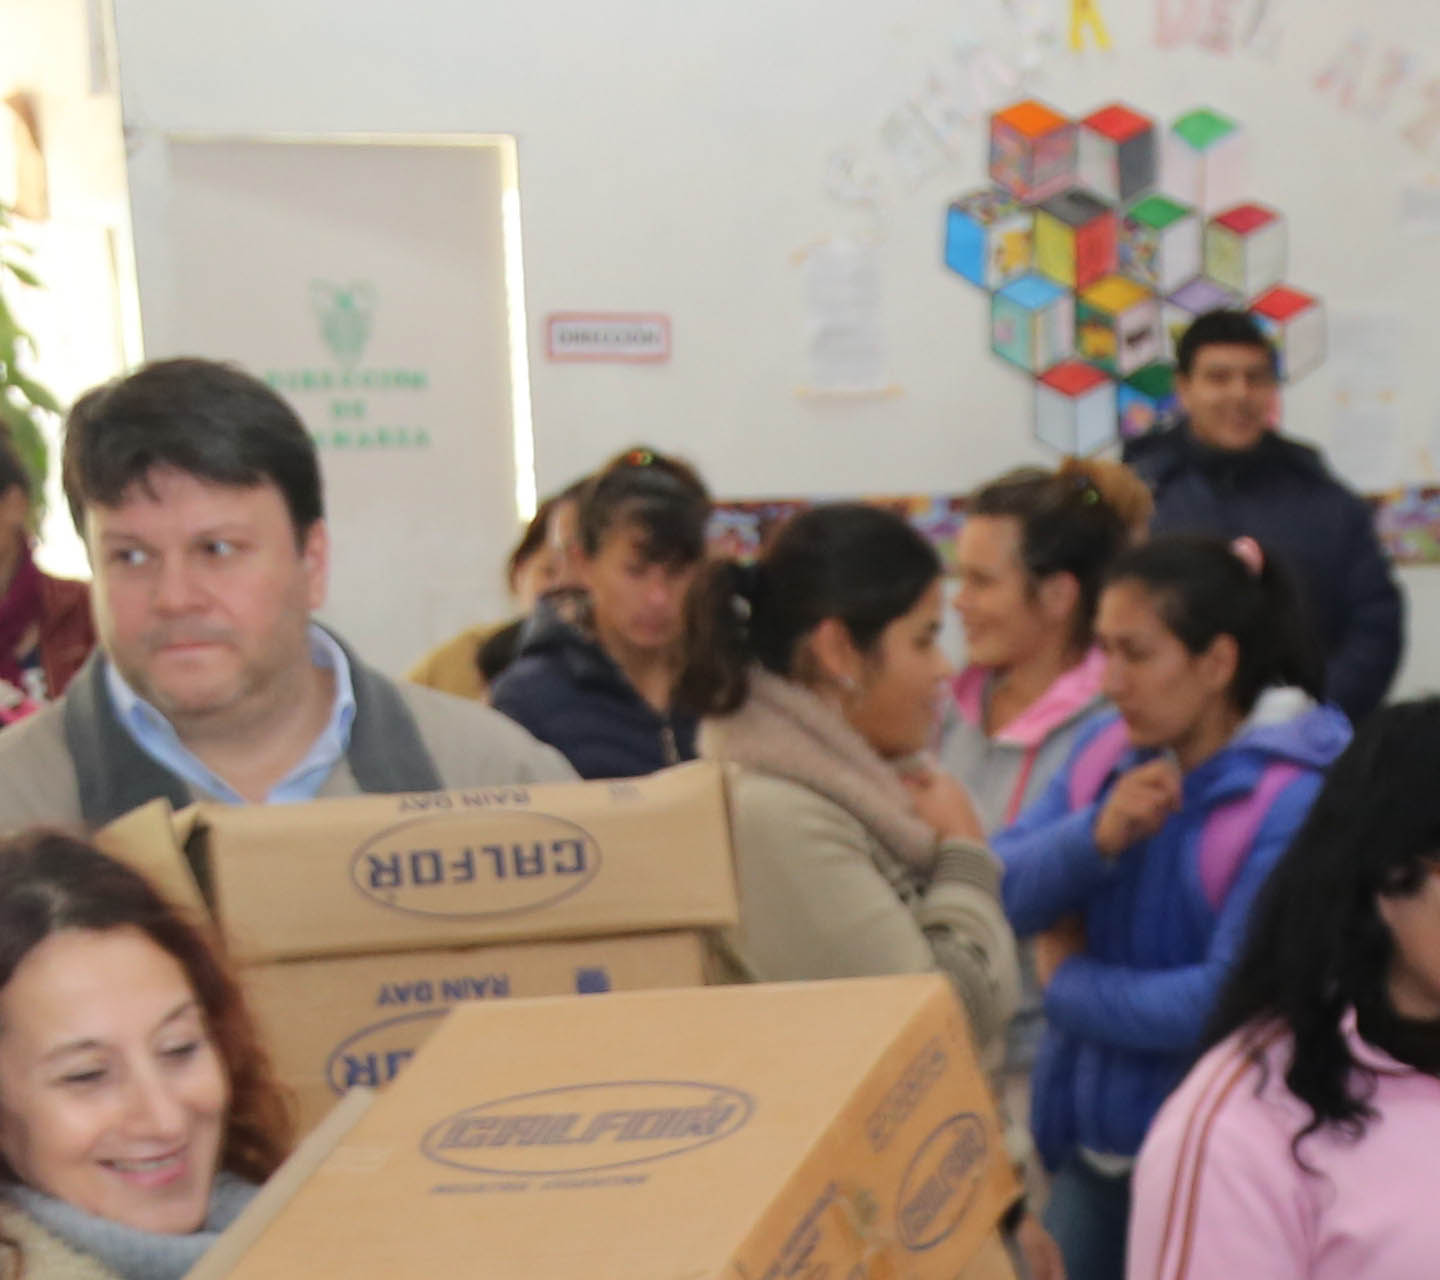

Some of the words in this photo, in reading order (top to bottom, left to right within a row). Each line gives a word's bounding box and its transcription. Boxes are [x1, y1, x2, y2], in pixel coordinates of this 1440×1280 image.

[368, 838, 586, 890] CALFOR
[377, 981, 434, 1006] DAY
[442, 975, 510, 1000] RAIN
[438, 1096, 738, 1152] CALFOR
